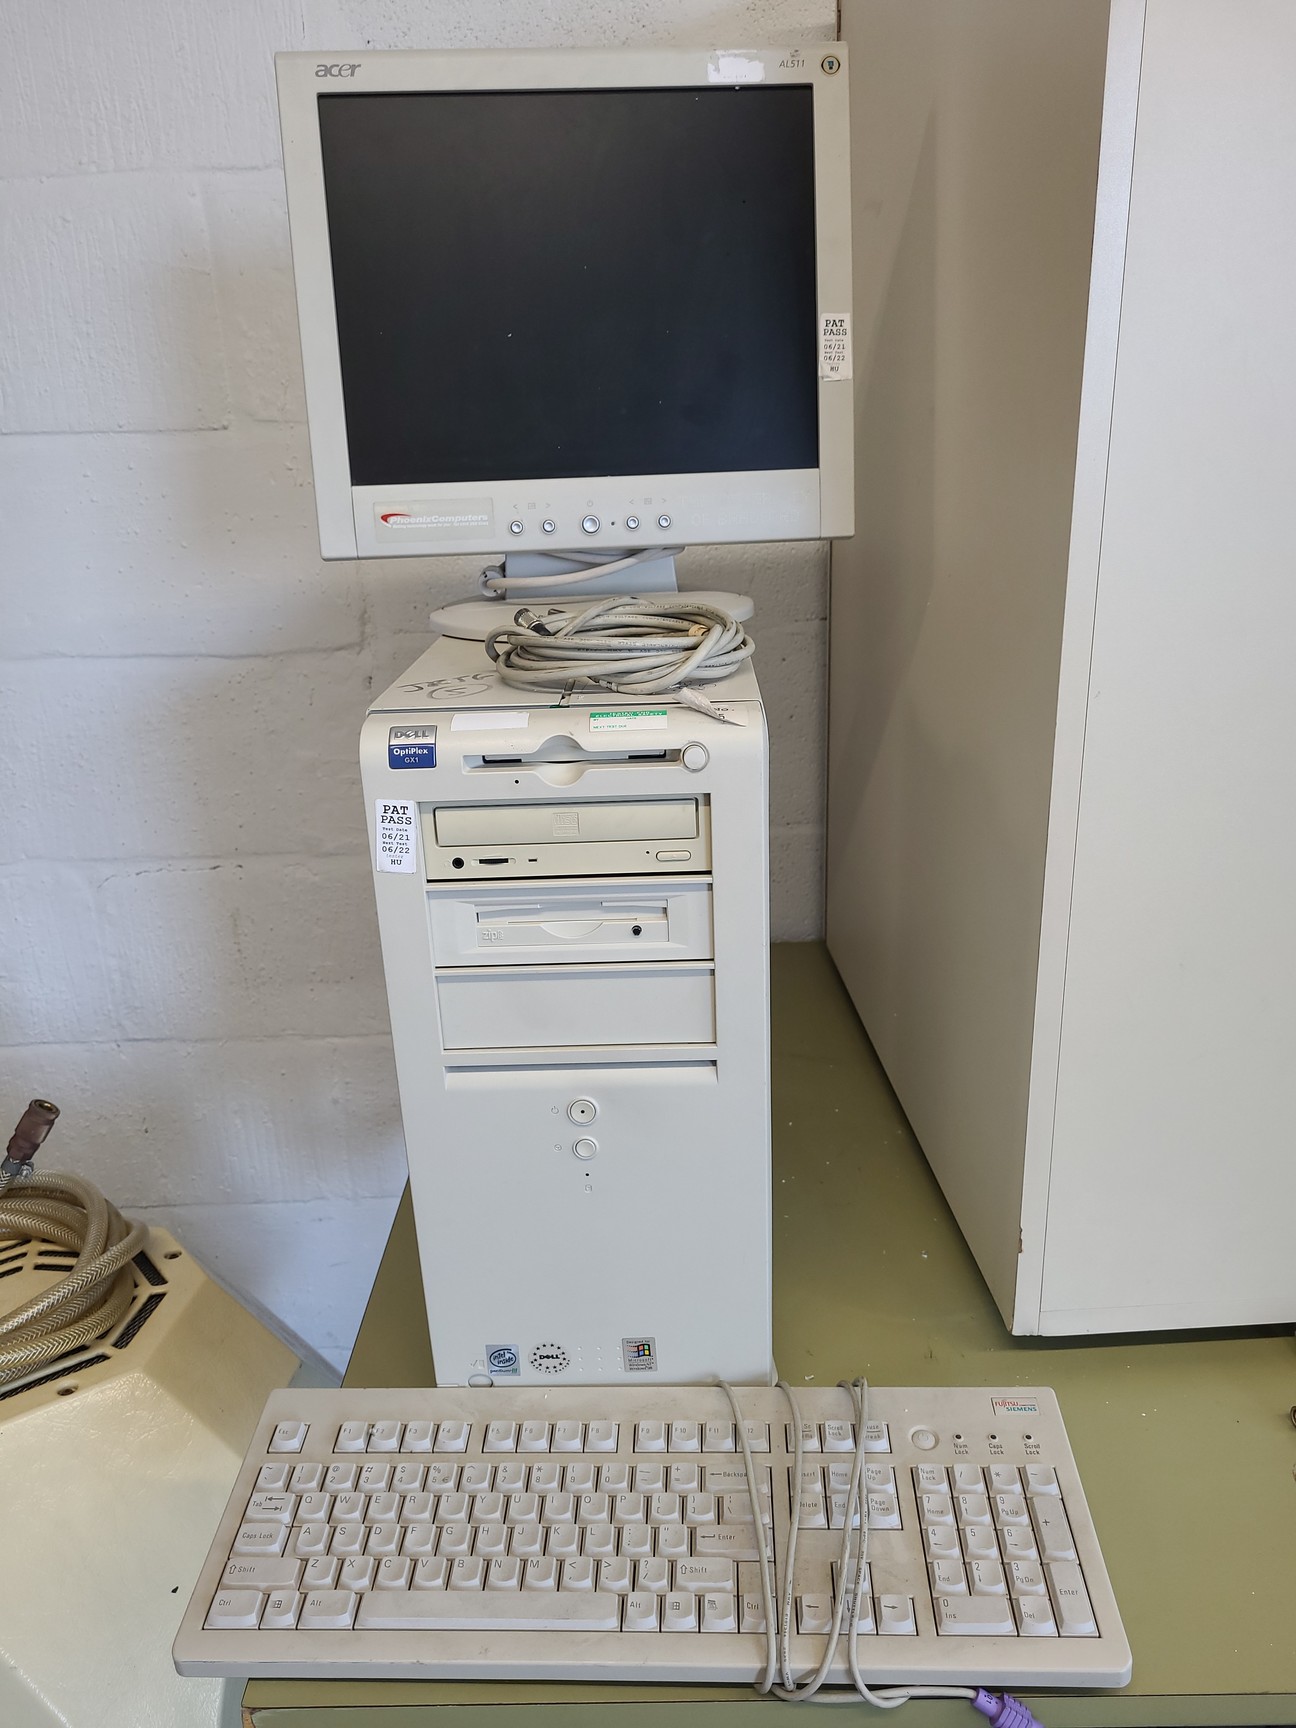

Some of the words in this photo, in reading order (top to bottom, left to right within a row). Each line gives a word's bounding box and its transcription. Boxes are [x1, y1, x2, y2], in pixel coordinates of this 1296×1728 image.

[315, 63, 361, 78] acer
[825, 319, 845, 327] PAT
[823, 328, 847, 336] PASS
[394, 730, 429, 740] DELL
[393, 747, 428, 756] OptiPlex
[382, 804, 408, 815] PAT
[381, 815, 412, 825] PASS
[382, 832, 410, 841] 06/21
[382, 846, 410, 854] 06/22
[995, 1400, 1018, 1408] FUJITSU
[866, 1467, 882, 1475] Page
[305, 1495, 313, 1504] Q
[340, 1495, 350, 1504] W
[374, 1495, 382, 1504] E
[409, 1495, 416, 1504] R
[445, 1495, 452, 1504] T
[480, 1495, 487, 1504] Y
[514, 1495, 521, 1504] U
[584, 1495, 592, 1504] O
[619, 1495, 627, 1504] P
[870, 1498, 886, 1506] Page
[926, 1496, 931, 1504] 7
[962, 1496, 967, 1504] 8
[1000, 1496, 1005, 1504] 9
[835, 1501, 846, 1509] End
[303, 1526, 311, 1535] A
[339, 1526, 346, 1535] S
[374, 1526, 382, 1535] D
[410, 1526, 417, 1535] F
[446, 1526, 454, 1535] G
[482, 1526, 489, 1535] H
[518, 1526, 525, 1535] J
[553, 1526, 560, 1535] K
[590, 1526, 596, 1535] L
[1007, 1529, 1012, 1537] 6
[311, 1559, 319, 1568] Z
[347, 1559, 356, 1568] X
[384, 1559, 392, 1568] C
[421, 1559, 429, 1568] V
[458, 1559, 465, 1568] B
[494, 1559, 502, 1568] N
[529, 1559, 540, 1568] M
[936, 1562, 941, 1570] 1
[974, 1562, 981, 1571] 2
[1013, 1562, 1020, 1571] 3
[237, 1565, 256, 1573] Shift
[1059, 1588, 1078, 1596] Enter
[310, 1599, 322, 1607] Alt
[629, 1601, 641, 1609] Alt
[746, 1602, 759, 1610] Ctrl
[942, 1598, 949, 1607] 0
